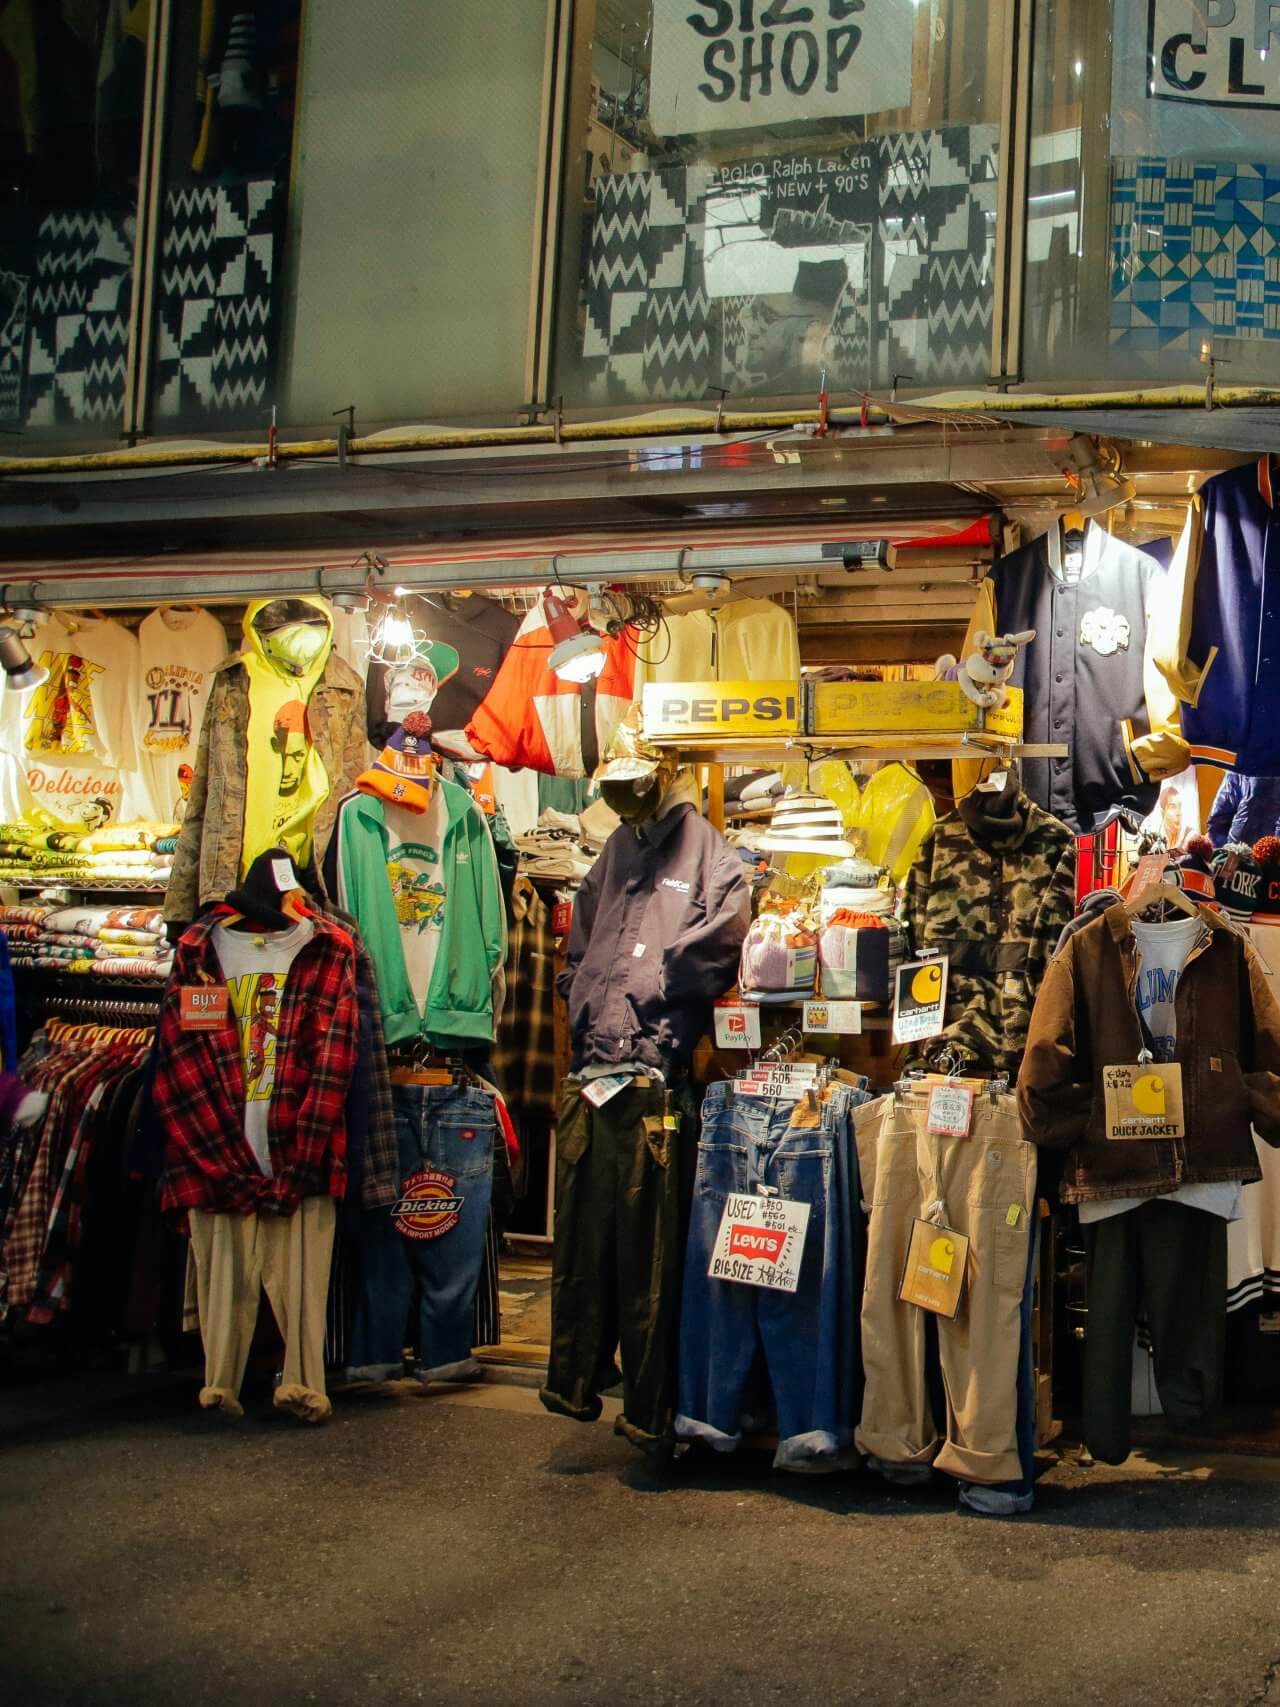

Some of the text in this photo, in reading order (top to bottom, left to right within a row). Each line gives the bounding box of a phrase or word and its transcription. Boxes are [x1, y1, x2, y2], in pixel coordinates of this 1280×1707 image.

[686, 0, 865, 37] SIZ
[698, 25, 862, 102] SHOP
[773, 158, 812, 181] Ralph
[817, 155, 871, 174] Lauen
[777, 183, 812, 200] NEW
[834, 174, 869, 193] 90'S
[661, 697, 796, 723] PEPSI
[191, 993, 218, 1005] BUY
[900, 1002, 940, 1017] carhartt
[725, 1033, 752, 1042] PayPay
[763, 1083, 782, 1097] 560
[1112, 1125, 1180, 1137] DUCK JACKET
[398, 1200, 457, 1213] Dickies
[727, 1199, 757, 1219] USED
[407, 1229, 433, 1240] IMPORT
[433, 1217, 459, 1237] MODEL
